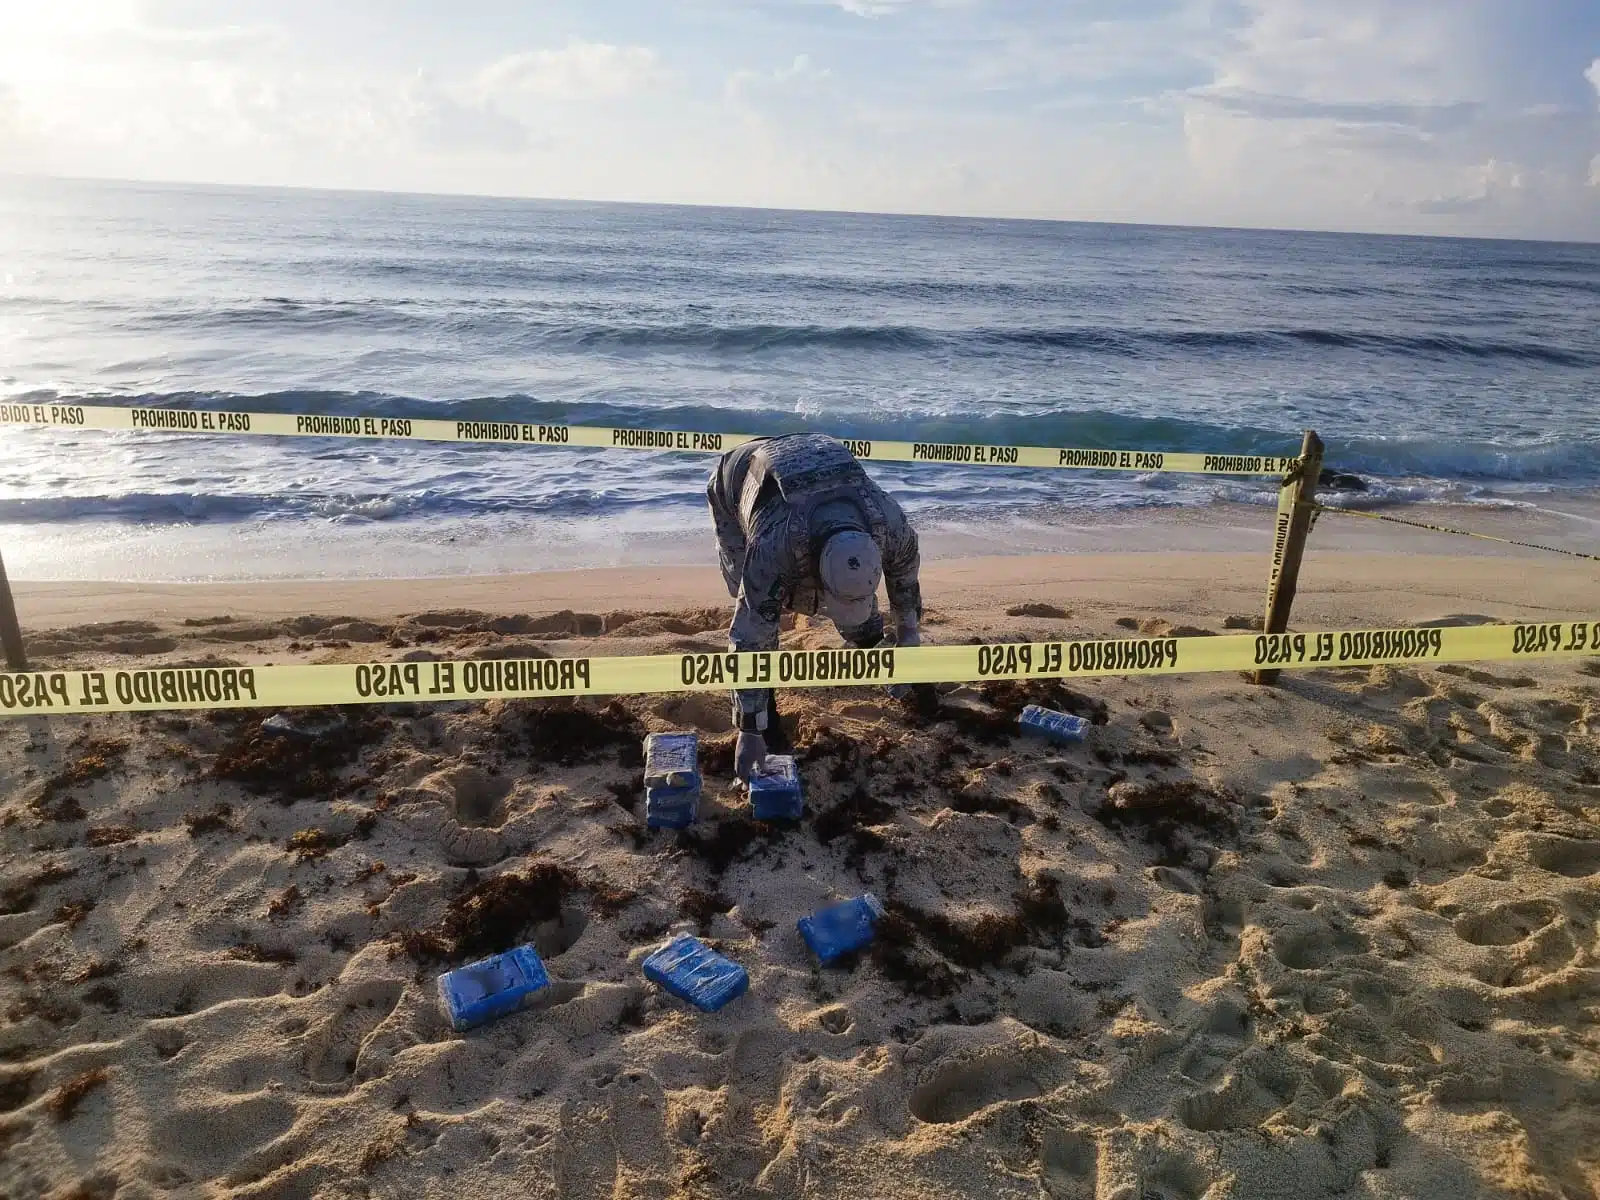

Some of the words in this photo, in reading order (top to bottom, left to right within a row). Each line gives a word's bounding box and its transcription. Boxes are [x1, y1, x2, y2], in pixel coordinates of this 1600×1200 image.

[0, 405, 30, 423] BIDO
[34, 406, 48, 423] EL
[52, 407, 84, 424] PASO
[132, 410, 197, 428] PROHIBIDO
[202, 413, 215, 429] EL
[219, 413, 250, 430] PASO
[297, 416, 360, 434] PROHIBIDO
[364, 419, 377, 434] EL
[381, 419, 411, 436] PASO
[457, 422, 518, 440] PROHIBIDO
[523, 425, 535, 441] EL
[539, 426, 568, 442] PASO
[614, 430, 672, 447] PROHIBIDO
[677, 433, 689, 448] EL
[693, 434, 721, 450] PASO
[913, 444, 971, 461] PROHIBIDO
[974, 447, 986, 462] EL
[990, 447, 1018, 463] PASO
[1060, 450, 1117, 467] PROHIBIDO
[1120, 453, 1131, 467] EL
[1135, 453, 1163, 468] PASO
[1204, 456, 1261, 471] PROHIBIDO
[1264, 458, 1275, 471] EL
